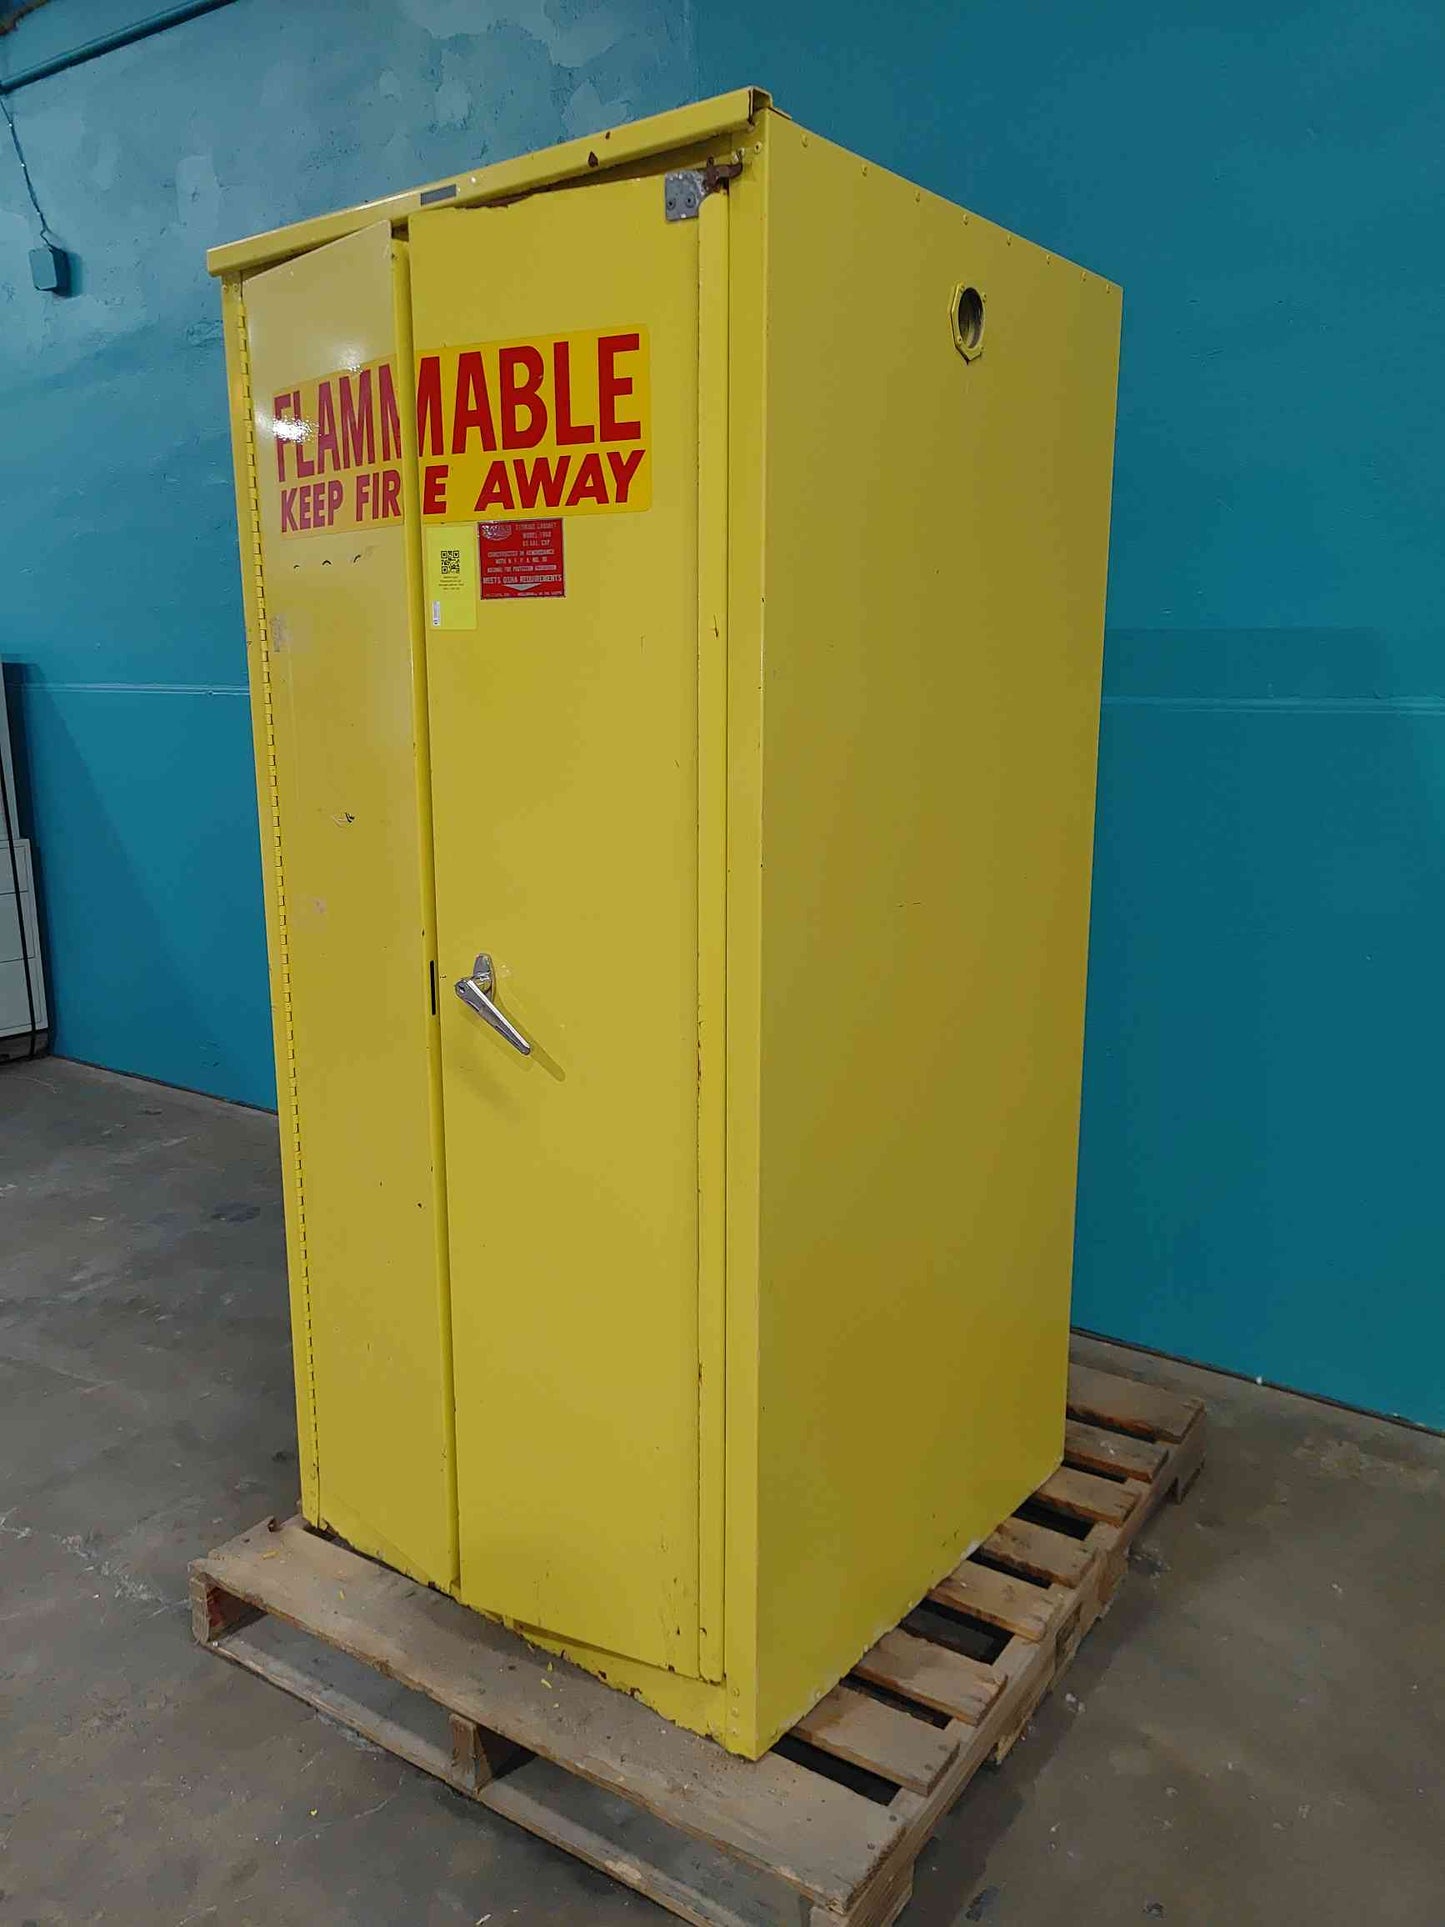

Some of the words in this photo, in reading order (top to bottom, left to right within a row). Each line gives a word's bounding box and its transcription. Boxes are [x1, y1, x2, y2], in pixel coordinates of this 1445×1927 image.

[273, 333, 641, 483] FLAMMABLE
[281, 479, 344, 533] KEEP
[356, 464, 448, 522] FIRE
[474, 450, 646, 512] AWAY
